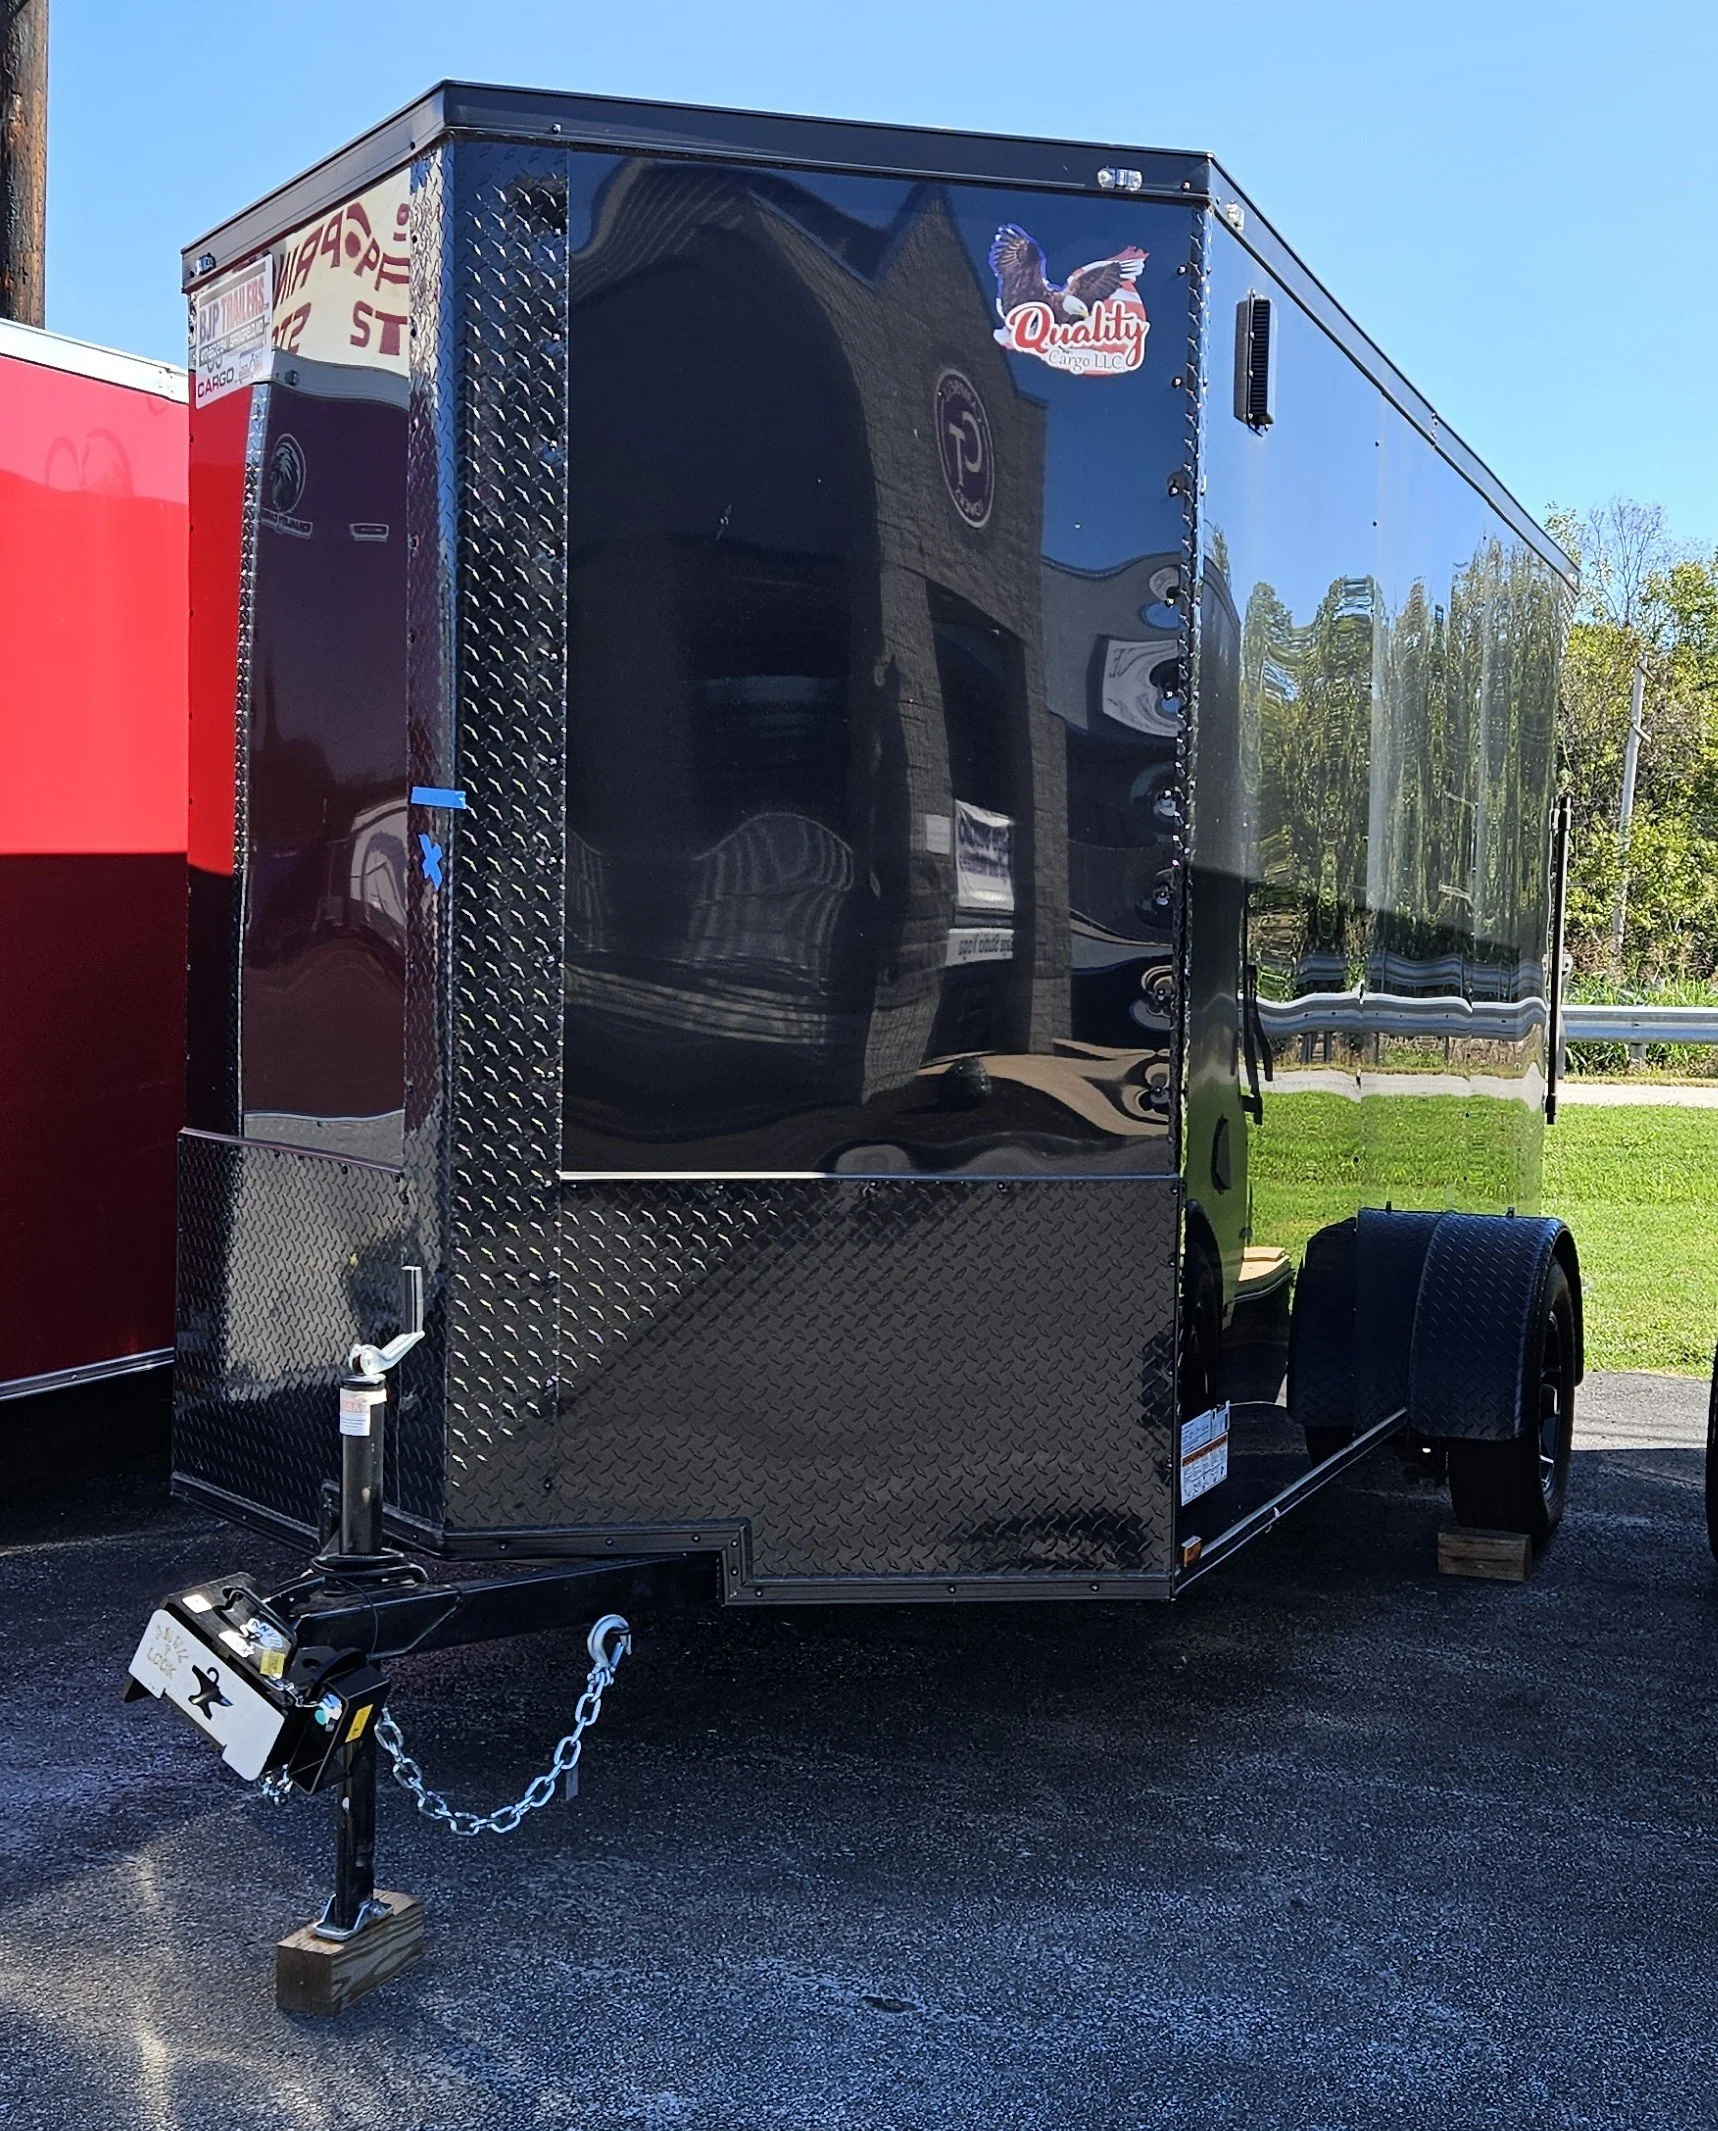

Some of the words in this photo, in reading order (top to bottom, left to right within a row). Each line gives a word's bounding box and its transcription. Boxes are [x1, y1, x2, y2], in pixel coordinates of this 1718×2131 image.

[199, 302, 220, 346] BJP
[221, 275, 265, 334] TRAILERS
[1009, 303, 1145, 367] Quality
[197, 367, 234, 397] CARGO
[1049, 350, 1091, 370] Cargo
